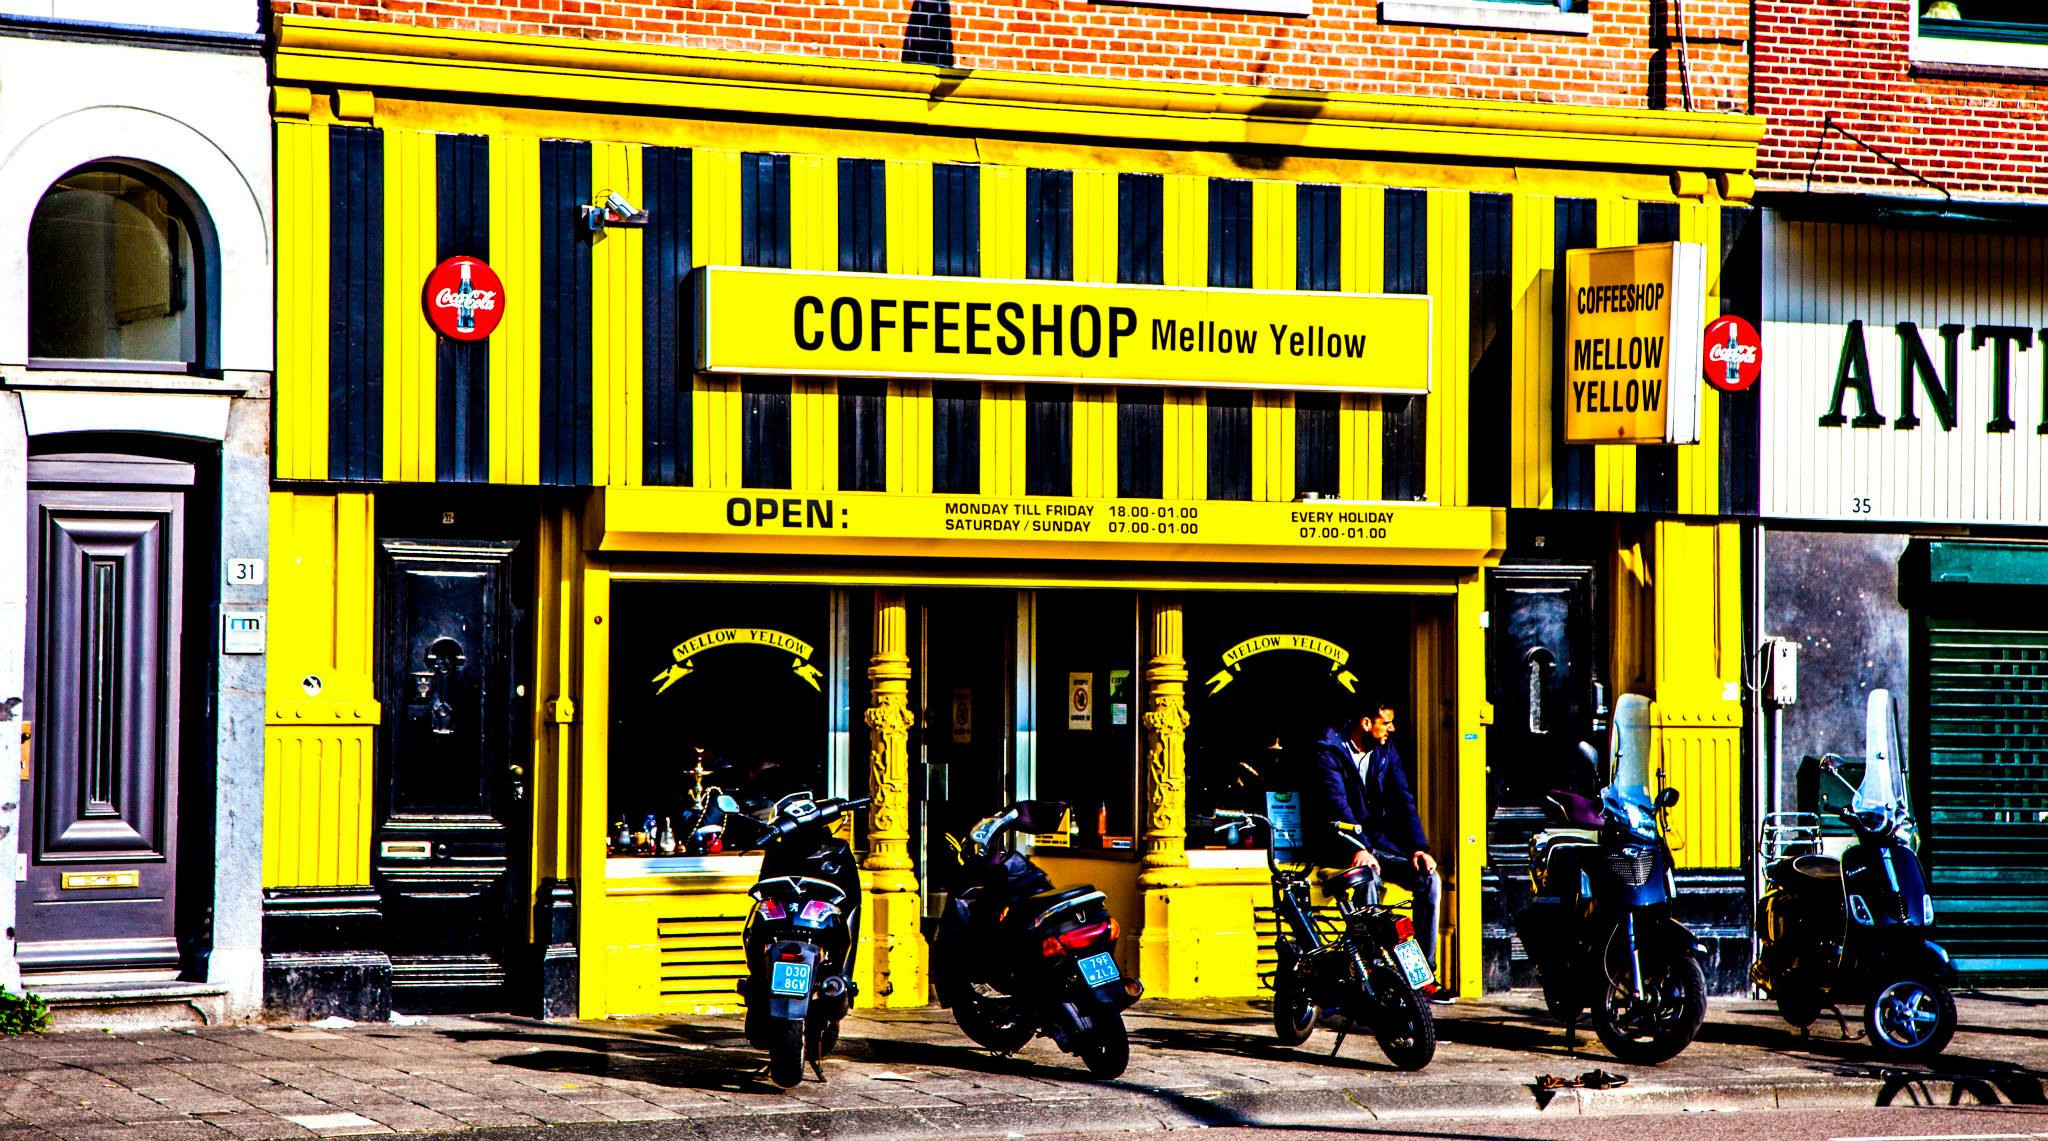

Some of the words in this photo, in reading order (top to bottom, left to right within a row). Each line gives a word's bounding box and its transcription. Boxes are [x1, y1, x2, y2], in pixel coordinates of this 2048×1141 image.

[1577, 282, 1665, 315] COFFEESHOP
[794, 295, 1138, 359] COFFEESHOP
[1151, 318, 1258, 354] Mellow
[1269, 323, 1366, 359] Yellow
[1574, 336, 1664, 371] MELLOW
[1572, 379, 1662, 413] YELLOW
[726, 497, 848, 529] OPEN:
[945, 502, 1009, 515] MONDAY
[1013, 504, 1041, 516] TILL
[1046, 504, 1094, 517] FRIDAY
[1291, 511, 1334, 523] EVERY
[1338, 512, 1394, 523] HOLIDAY
[1852, 497, 1872, 514] 35
[945, 518, 1021, 531] SATURDAY
[1032, 520, 1091, 532] SUNDAY
[236, 563, 254, 580] 31
[676, 629, 737, 658] MELLOW
[749, 629, 808, 654] YELLOW
[1227, 636, 1281, 661] MELLOW
[1292, 636, 1344, 660] YELLOW
